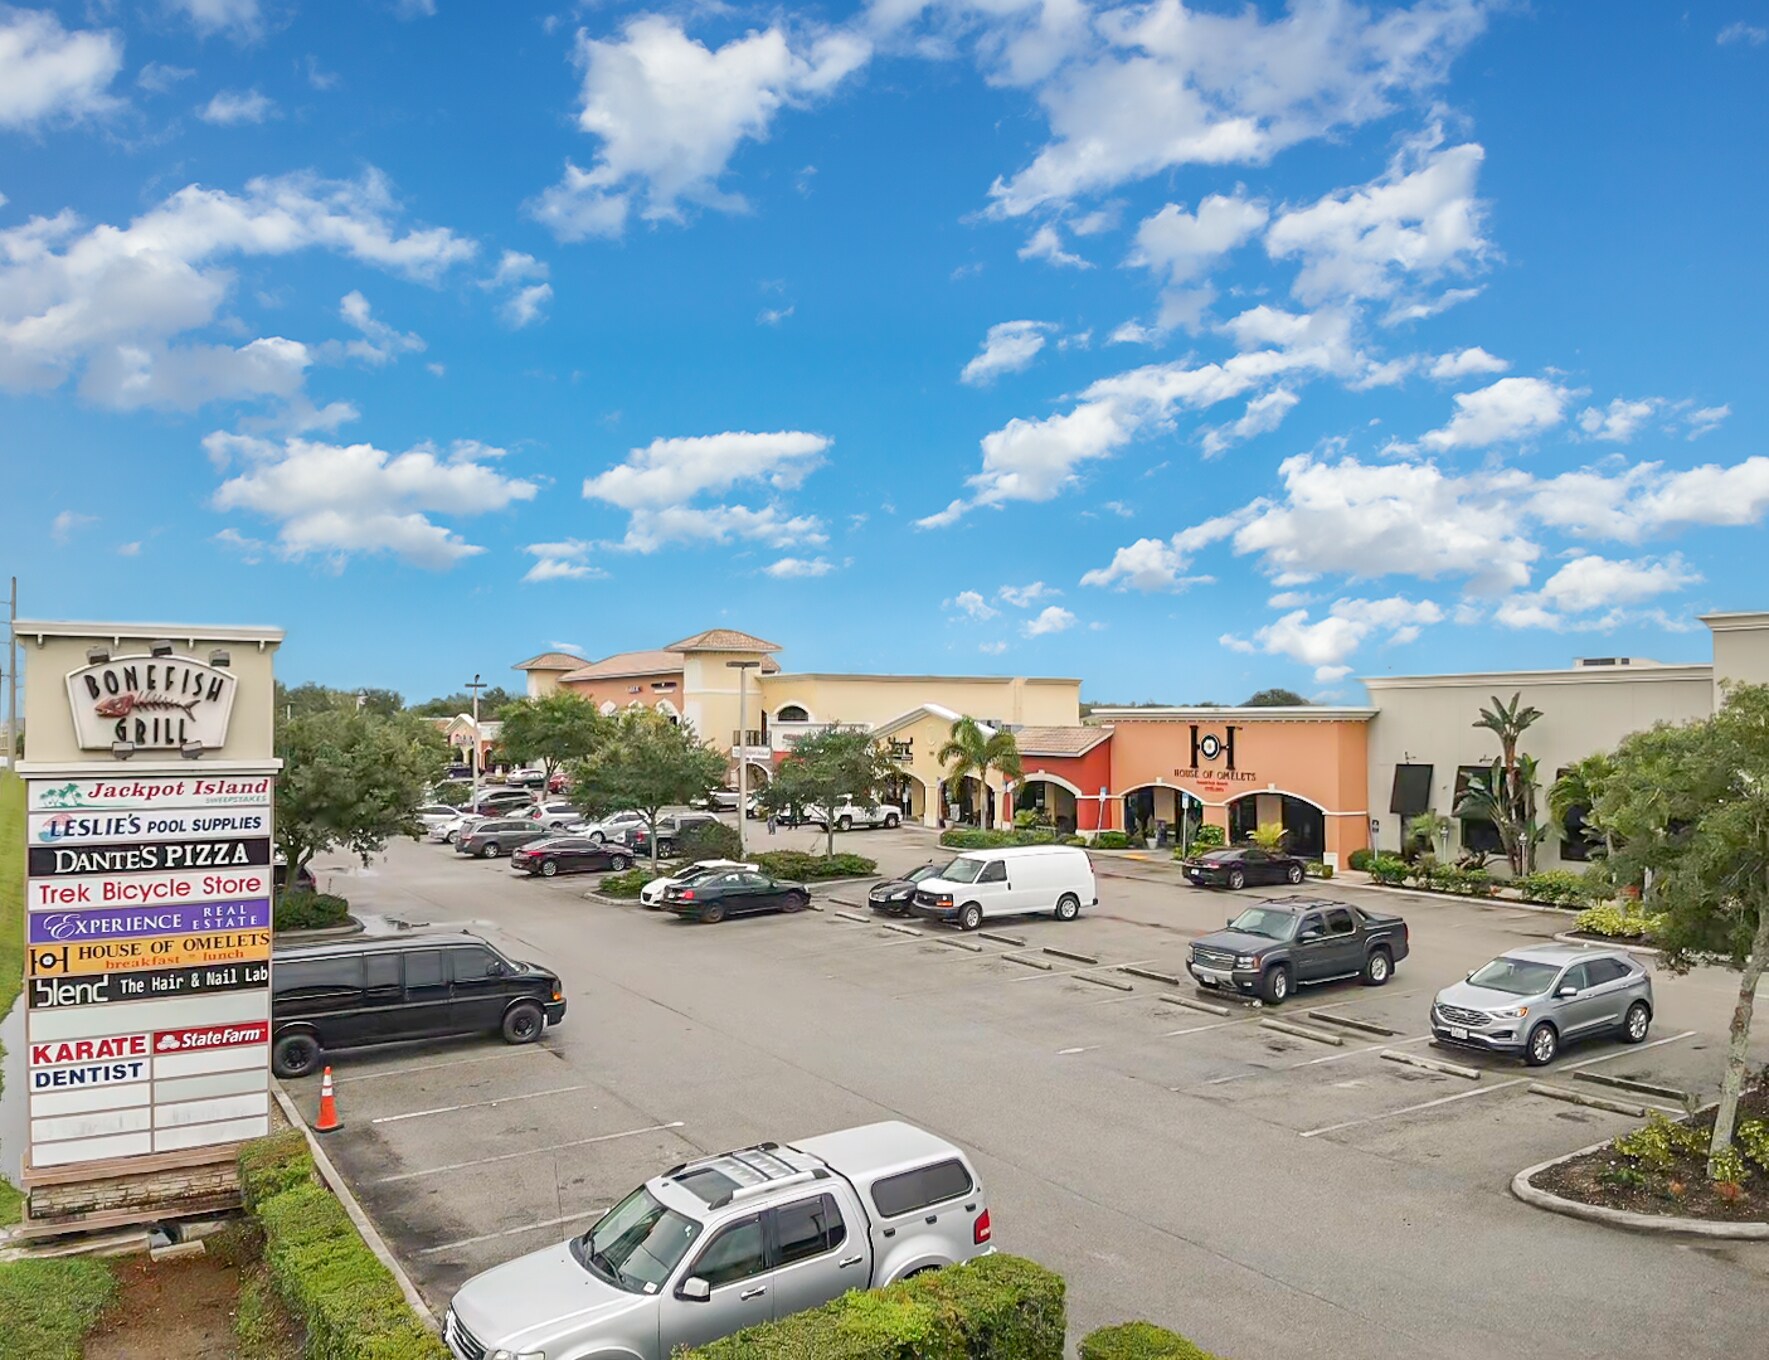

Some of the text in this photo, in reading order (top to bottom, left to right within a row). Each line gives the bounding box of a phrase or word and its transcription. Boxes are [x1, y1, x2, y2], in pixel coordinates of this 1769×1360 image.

[84, 665, 223, 701] BONEFISH
[115, 718, 187, 745] GRILL
[1174, 769, 1256, 781] HOUSE OF OMELETS
[88, 779, 268, 800] Jackpot Island
[50, 813, 261, 837] LESLIE'S POOL SUPPLIES
[165, 843, 249, 866] PIZZA
[40, 877, 261, 904] Trek Bicycle Store
[193, 916, 257, 929] ESTATE
[204, 906, 246, 915] REAL
[44, 914, 181, 939] EXPERIENCE
[79, 933, 269, 960] HOUSE OF OMELETS
[106, 950, 244, 969] breakfast lunch
[37, 967, 268, 1006] blend The Hair & Nail Lab
[33, 1036, 146, 1064] KARATE
[36, 1063, 143, 1088] DENTIST
